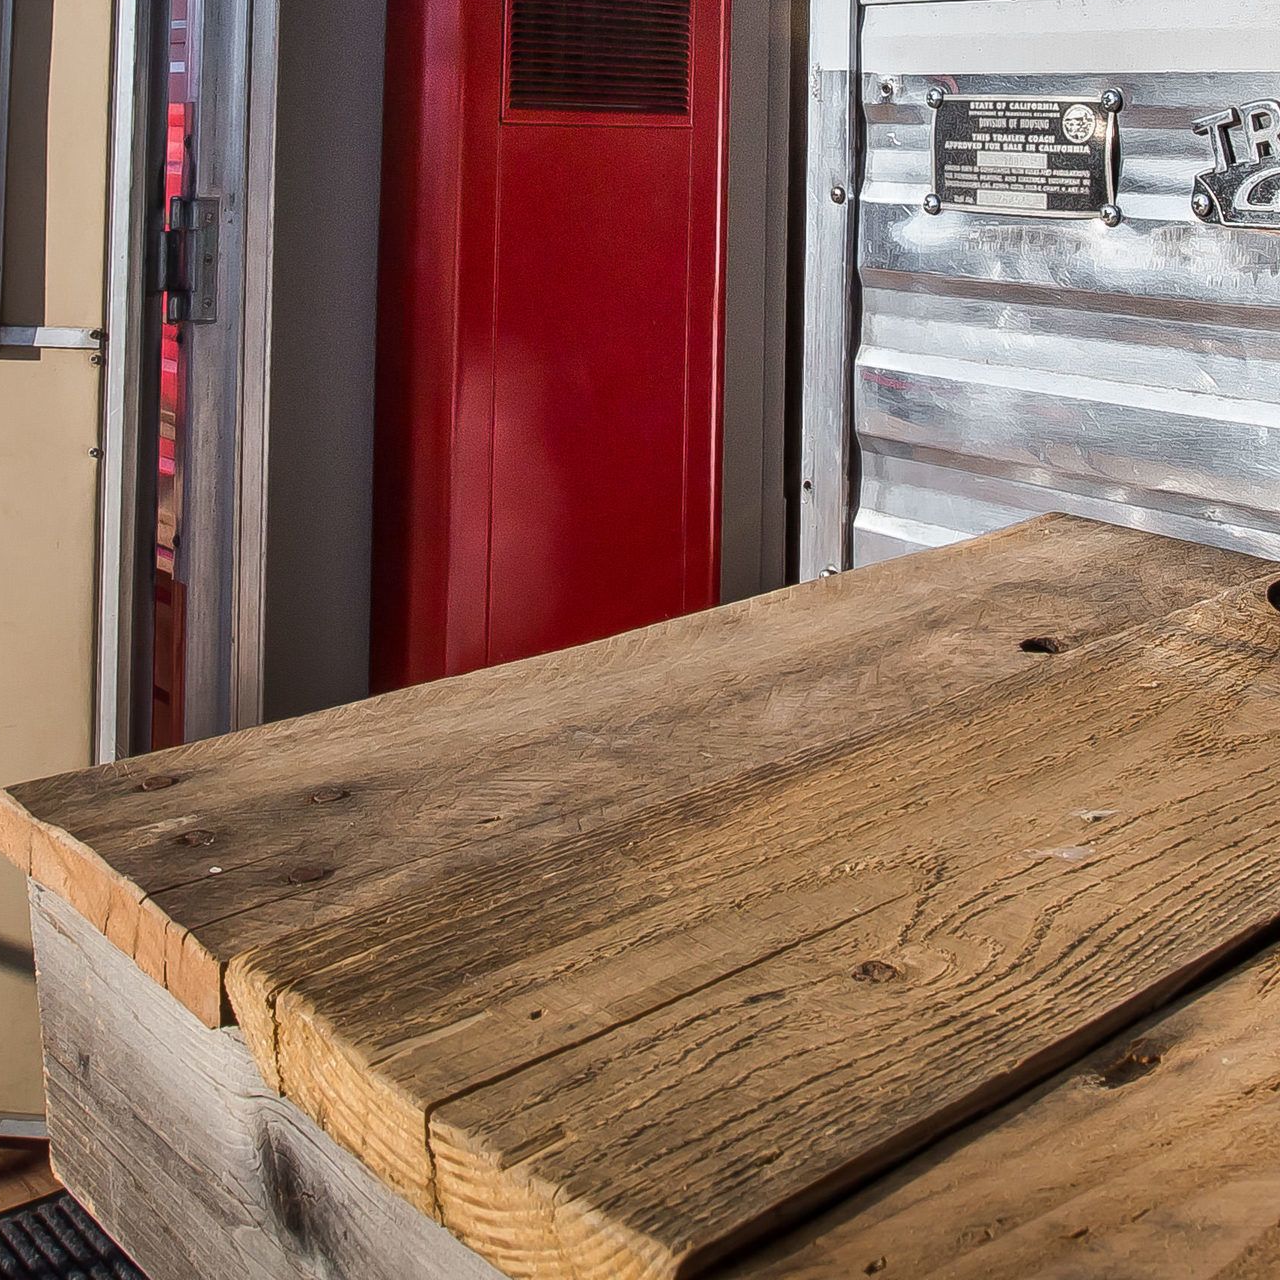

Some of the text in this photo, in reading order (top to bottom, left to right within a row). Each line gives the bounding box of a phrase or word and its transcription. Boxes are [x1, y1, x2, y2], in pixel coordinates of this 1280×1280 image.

[970, 101, 1060, 111] STATE OF CALIFORNIA
[979, 117, 1008, 128] DIVISION
[1020, 118, 1050, 130] HOUSING
[972, 133, 1055, 144] THIS TRAILER COACH
[945, 140, 1091, 154] APPROVED FOR SALE IN CALIFORNIA
